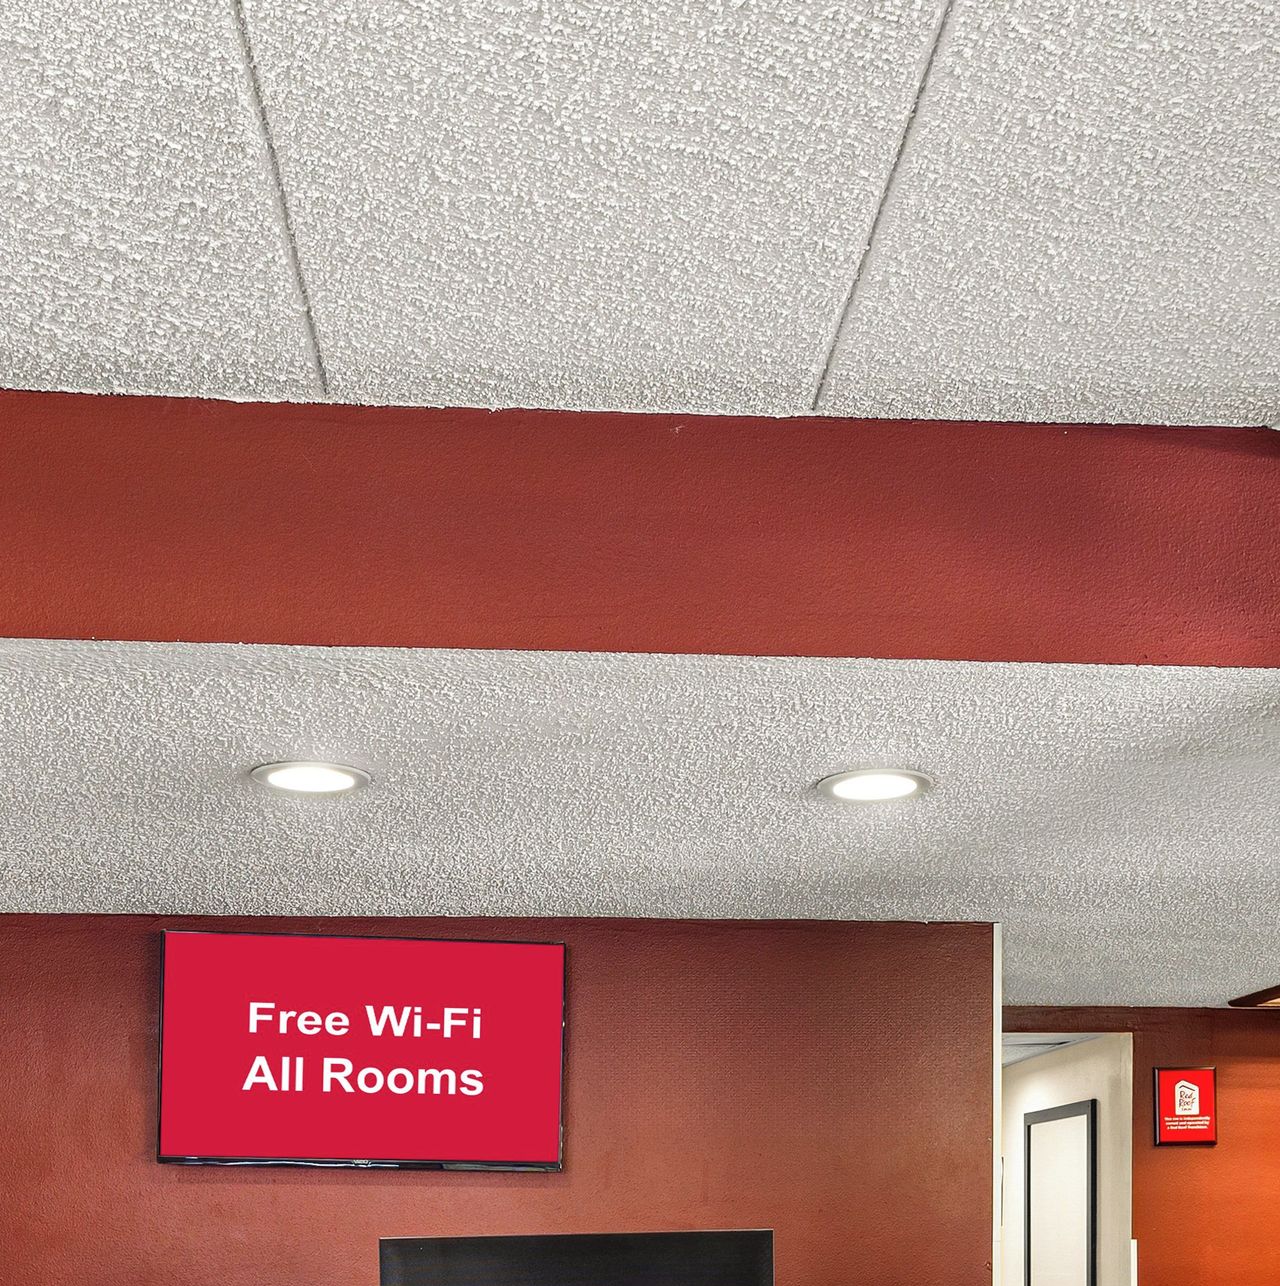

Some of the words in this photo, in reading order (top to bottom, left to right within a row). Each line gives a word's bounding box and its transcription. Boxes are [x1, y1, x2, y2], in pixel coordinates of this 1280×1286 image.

[248, 1001, 350, 1036] Free
[364, 1005, 482, 1039] Wi-Fi
[242, 1055, 304, 1092] All
[322, 1056, 484, 1096] Rooms
[1179, 1097, 1196, 1108] Roof
[1180, 1091, 1193, 1099] Red
